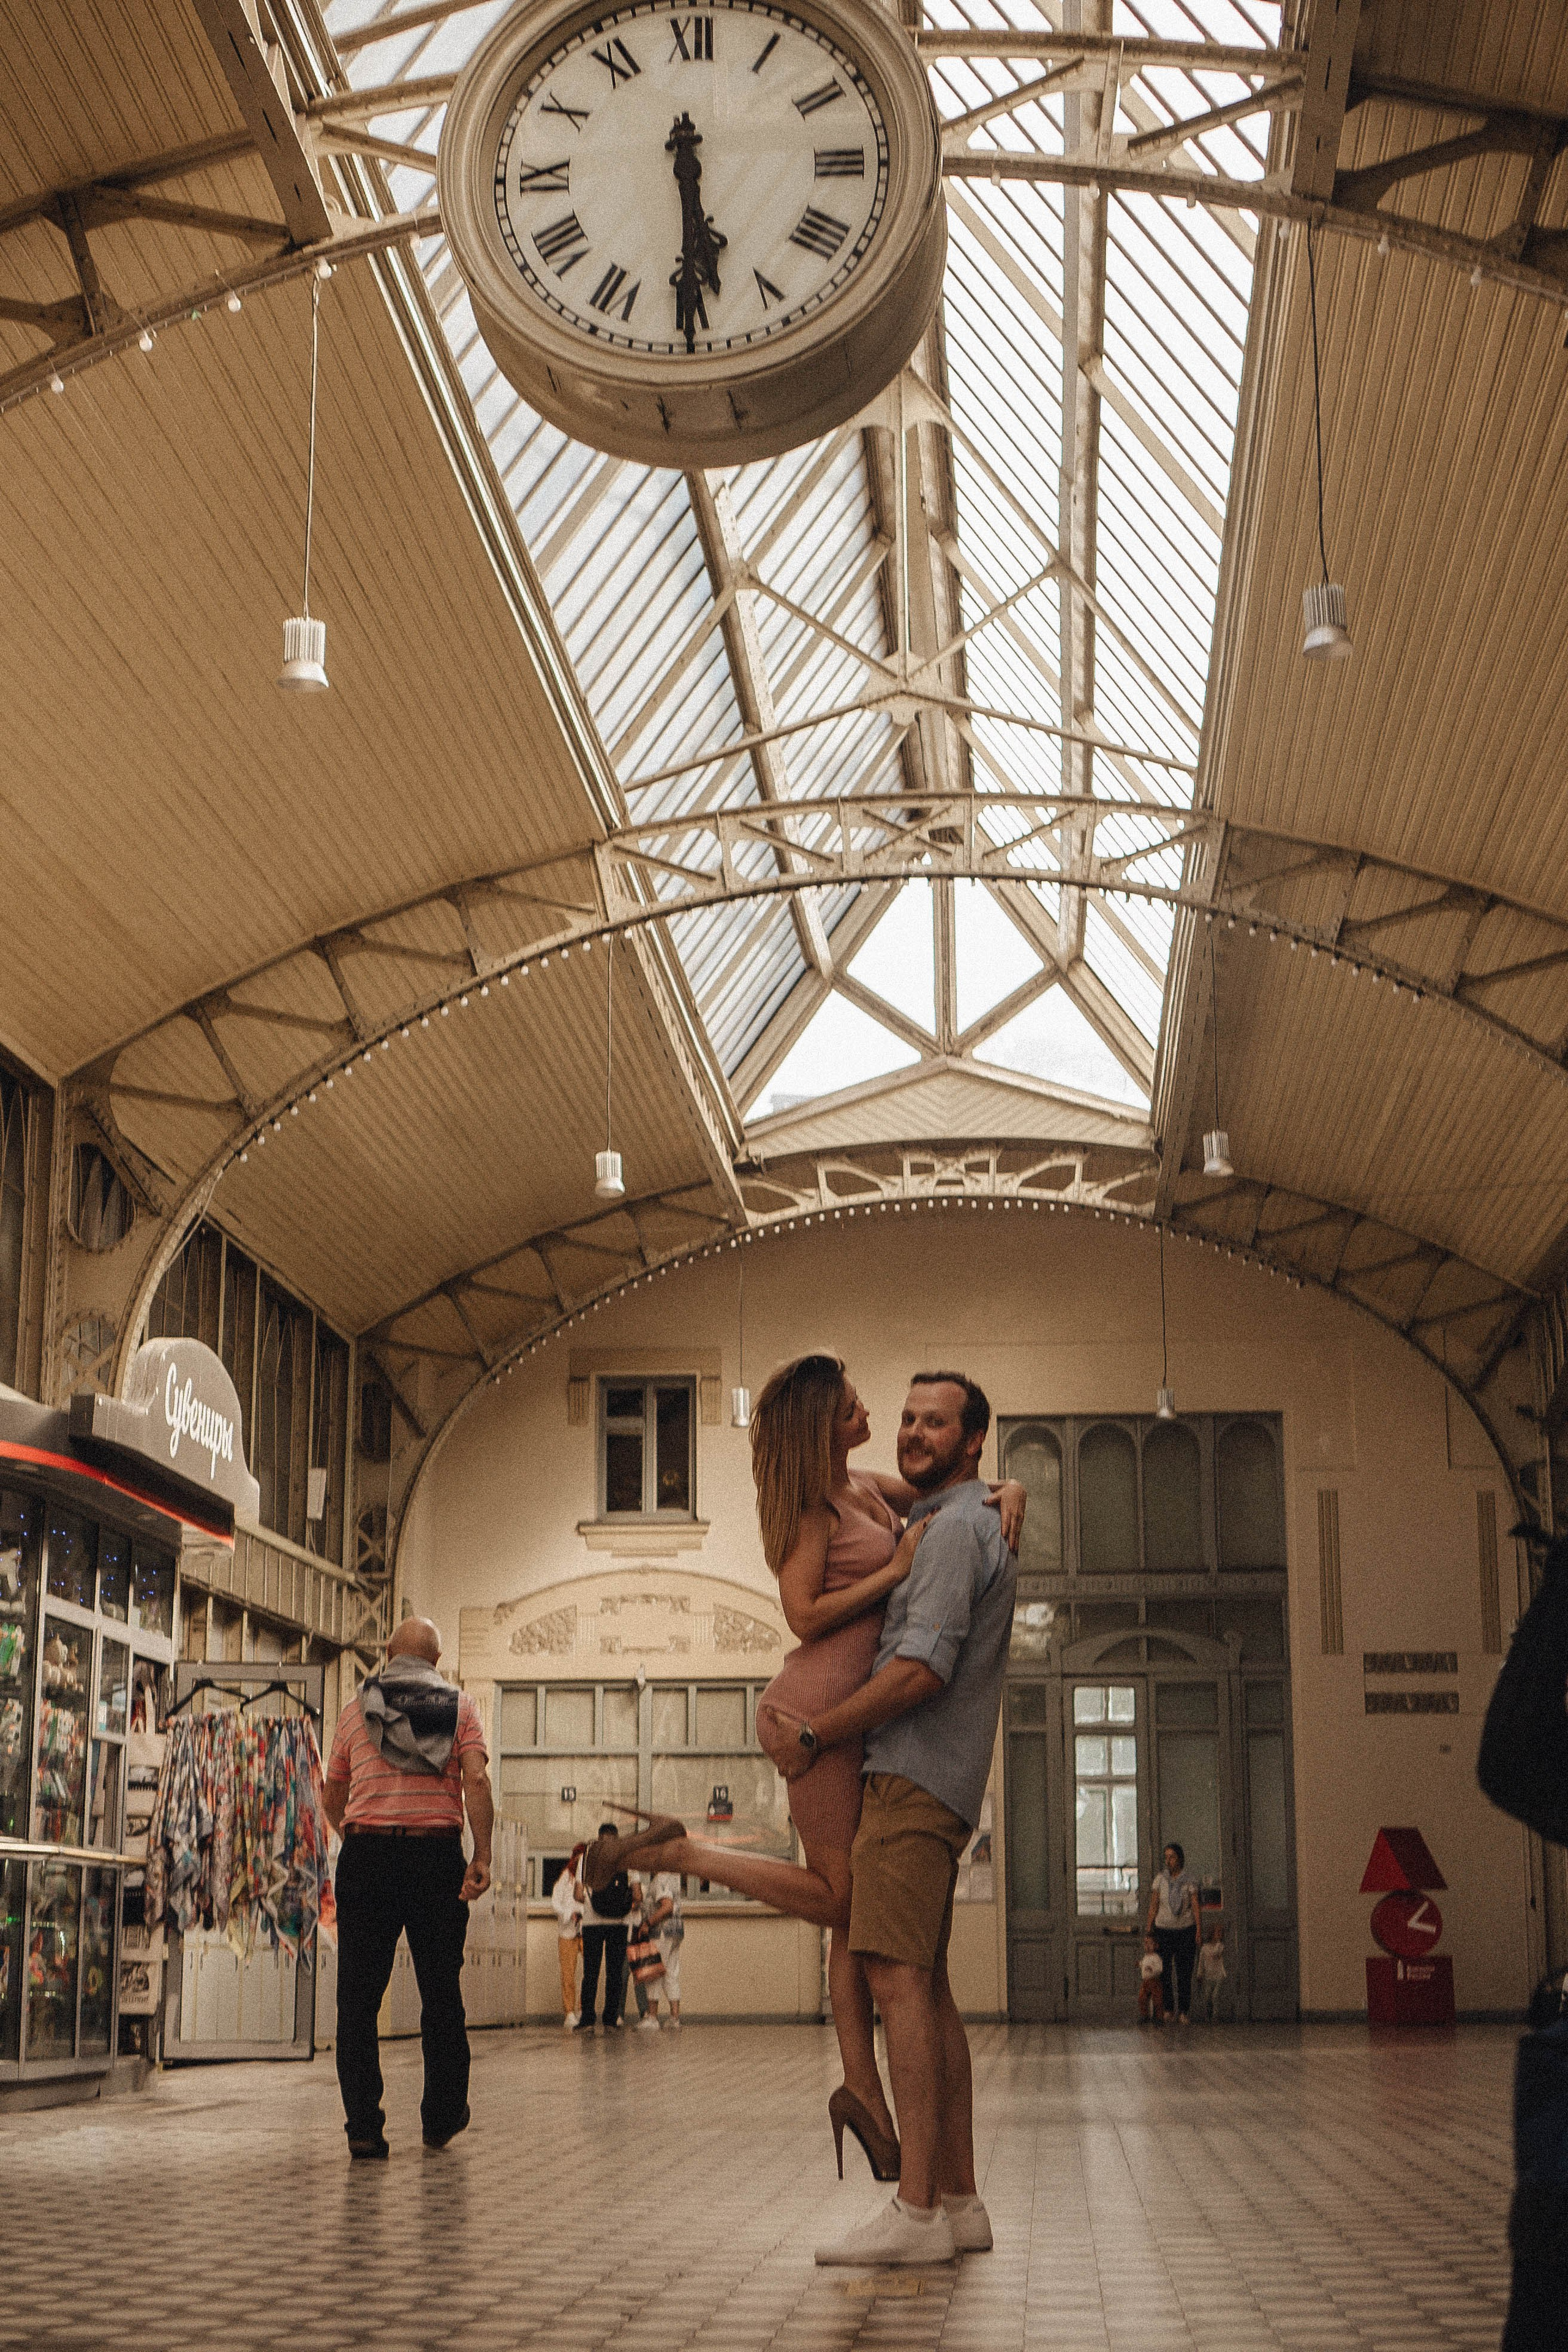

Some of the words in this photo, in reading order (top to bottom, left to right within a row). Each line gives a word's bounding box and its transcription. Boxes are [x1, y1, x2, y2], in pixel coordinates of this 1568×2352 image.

[669, 16, 713, 63] XII
[750, 32, 781, 74] I
[590, 37, 641, 89] XI
[540, 92, 589, 134] X
[792, 75, 846, 121] II
[519, 156, 570, 198] IX
[813, 145, 864, 183] III
[531, 208, 589, 281] VIII
[789, 205, 851, 262] IIII
[588, 262, 642, 322] VII
[753, 266, 786, 309] V
[165, 1362, 233, 1480] Сувениры
